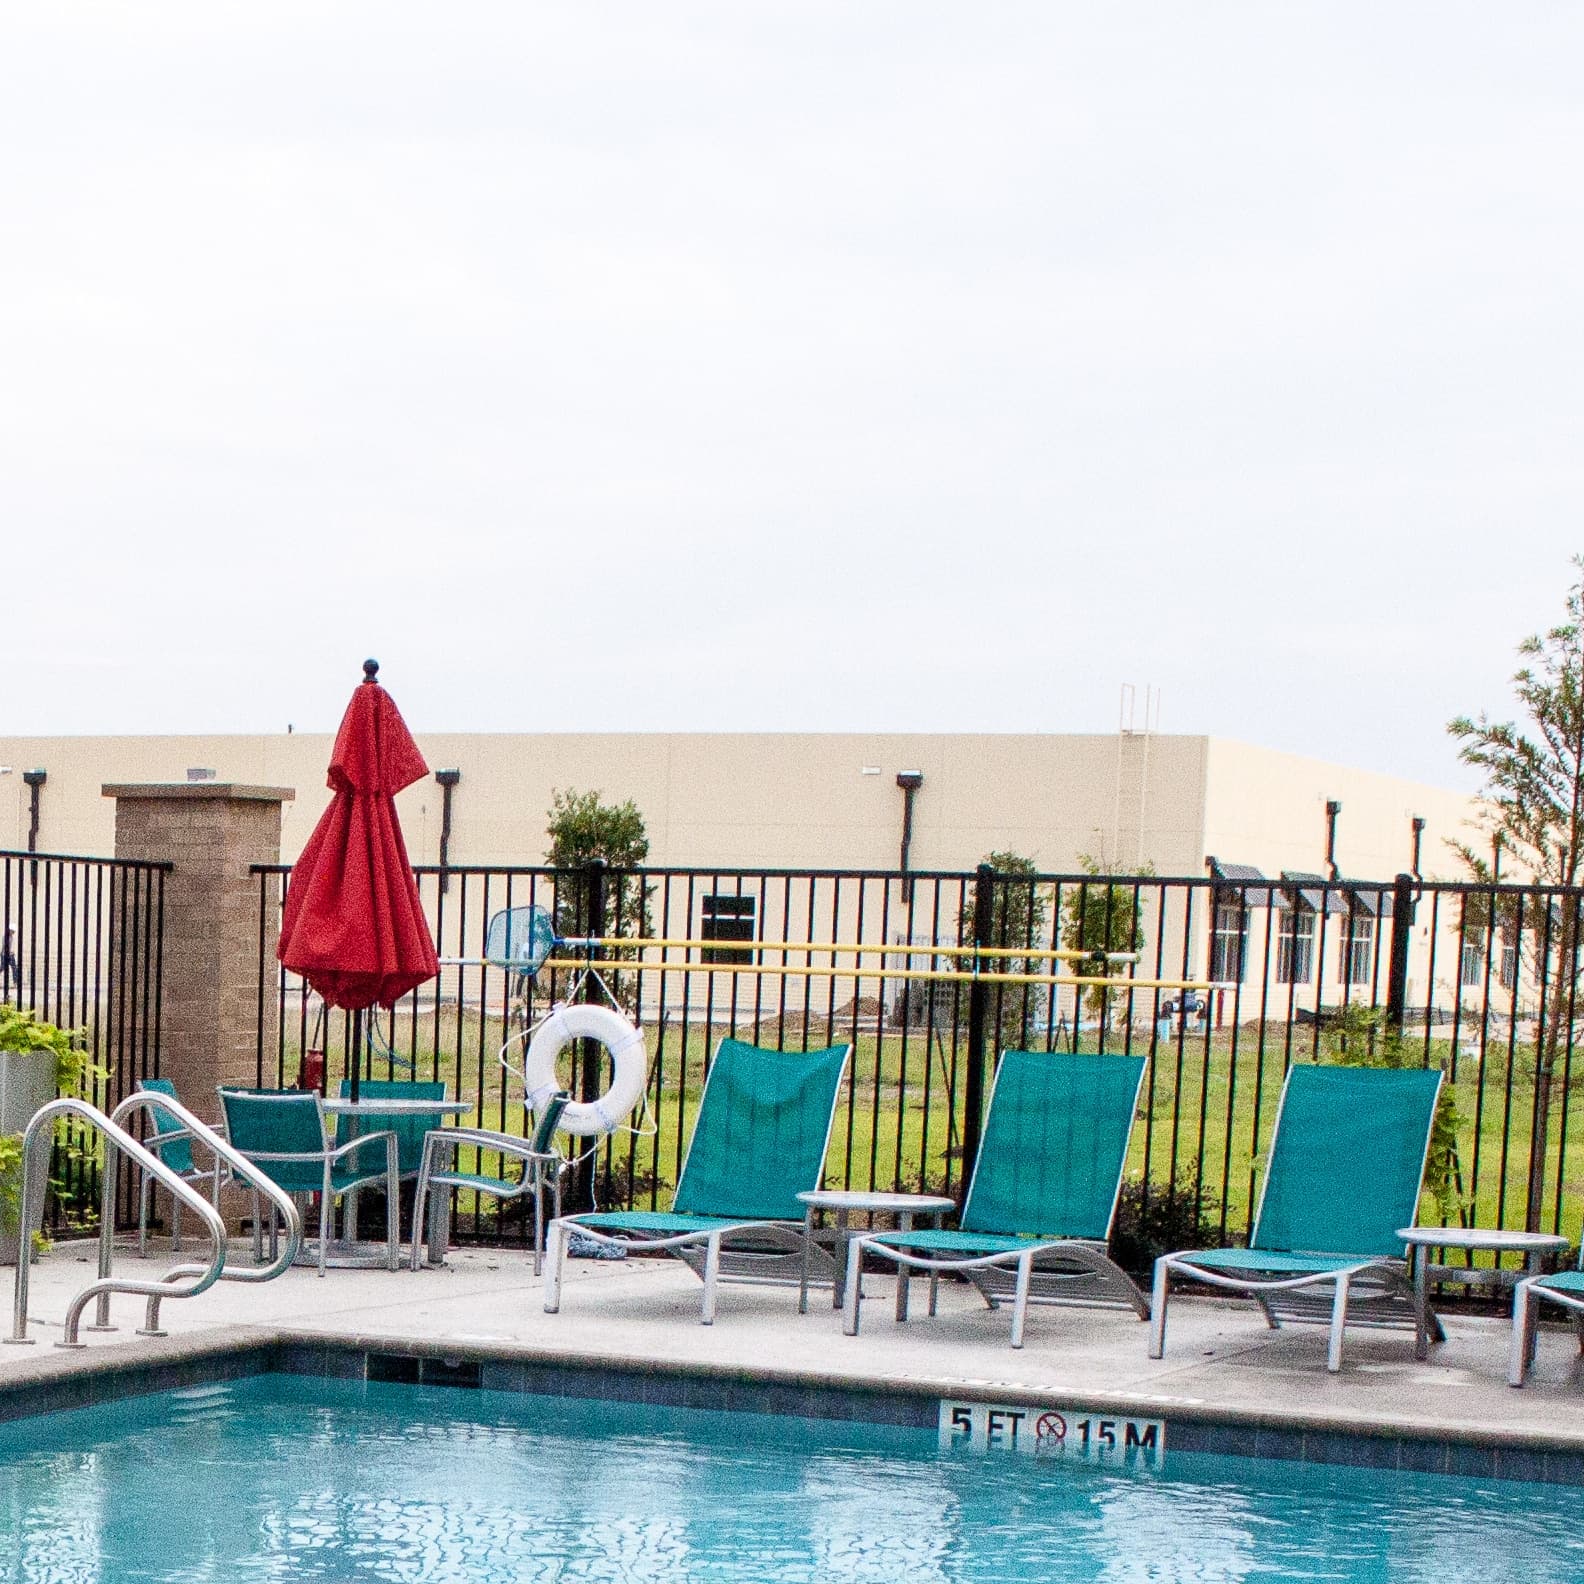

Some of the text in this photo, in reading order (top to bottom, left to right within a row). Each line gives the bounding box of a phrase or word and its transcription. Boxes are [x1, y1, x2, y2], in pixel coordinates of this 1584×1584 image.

[952, 1407, 972, 1433] 5
[988, 1410, 1025, 1437] FT
[1126, 1422, 1158, 1448] M
